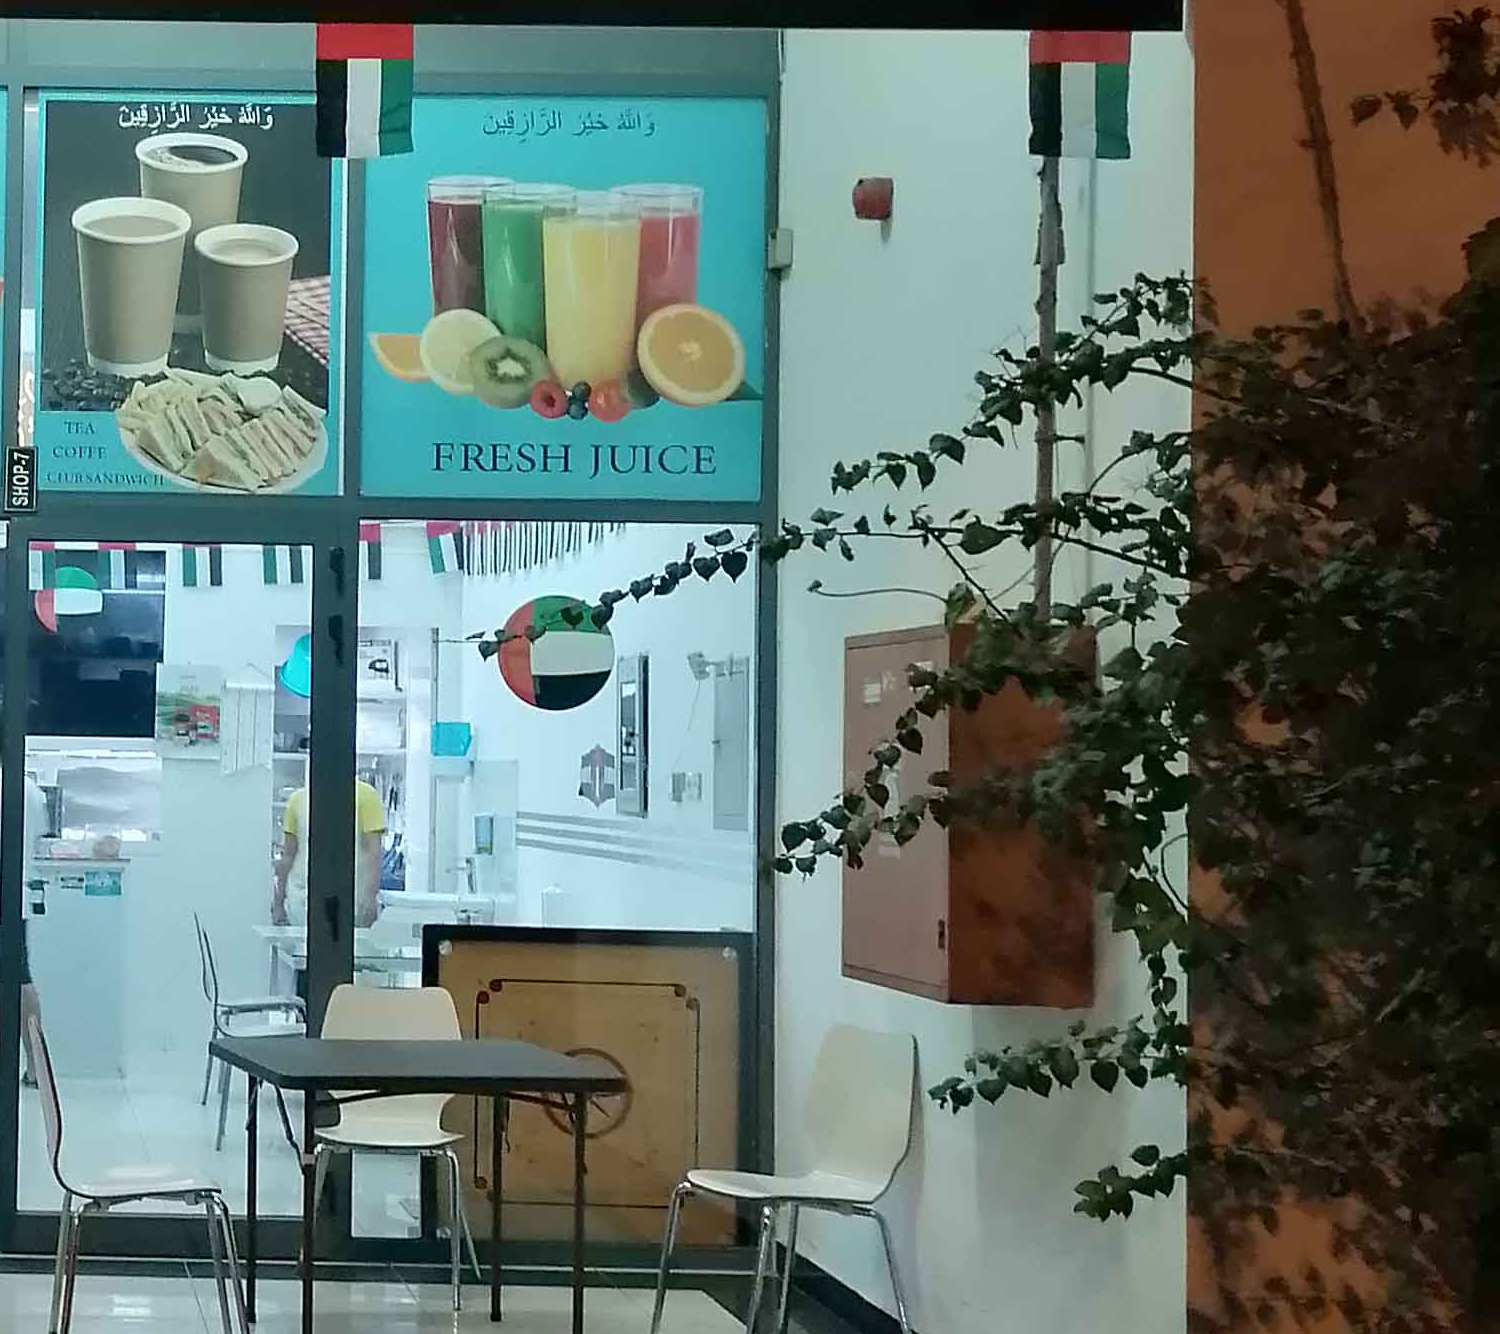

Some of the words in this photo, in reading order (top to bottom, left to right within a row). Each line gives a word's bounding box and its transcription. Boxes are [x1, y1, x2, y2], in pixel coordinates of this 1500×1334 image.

[64, 421, 95, 435] TEA
[12, 451, 31, 507] SHOP-7
[432, 442, 572, 473] FRESH
[588, 444, 717, 480] JUICE
